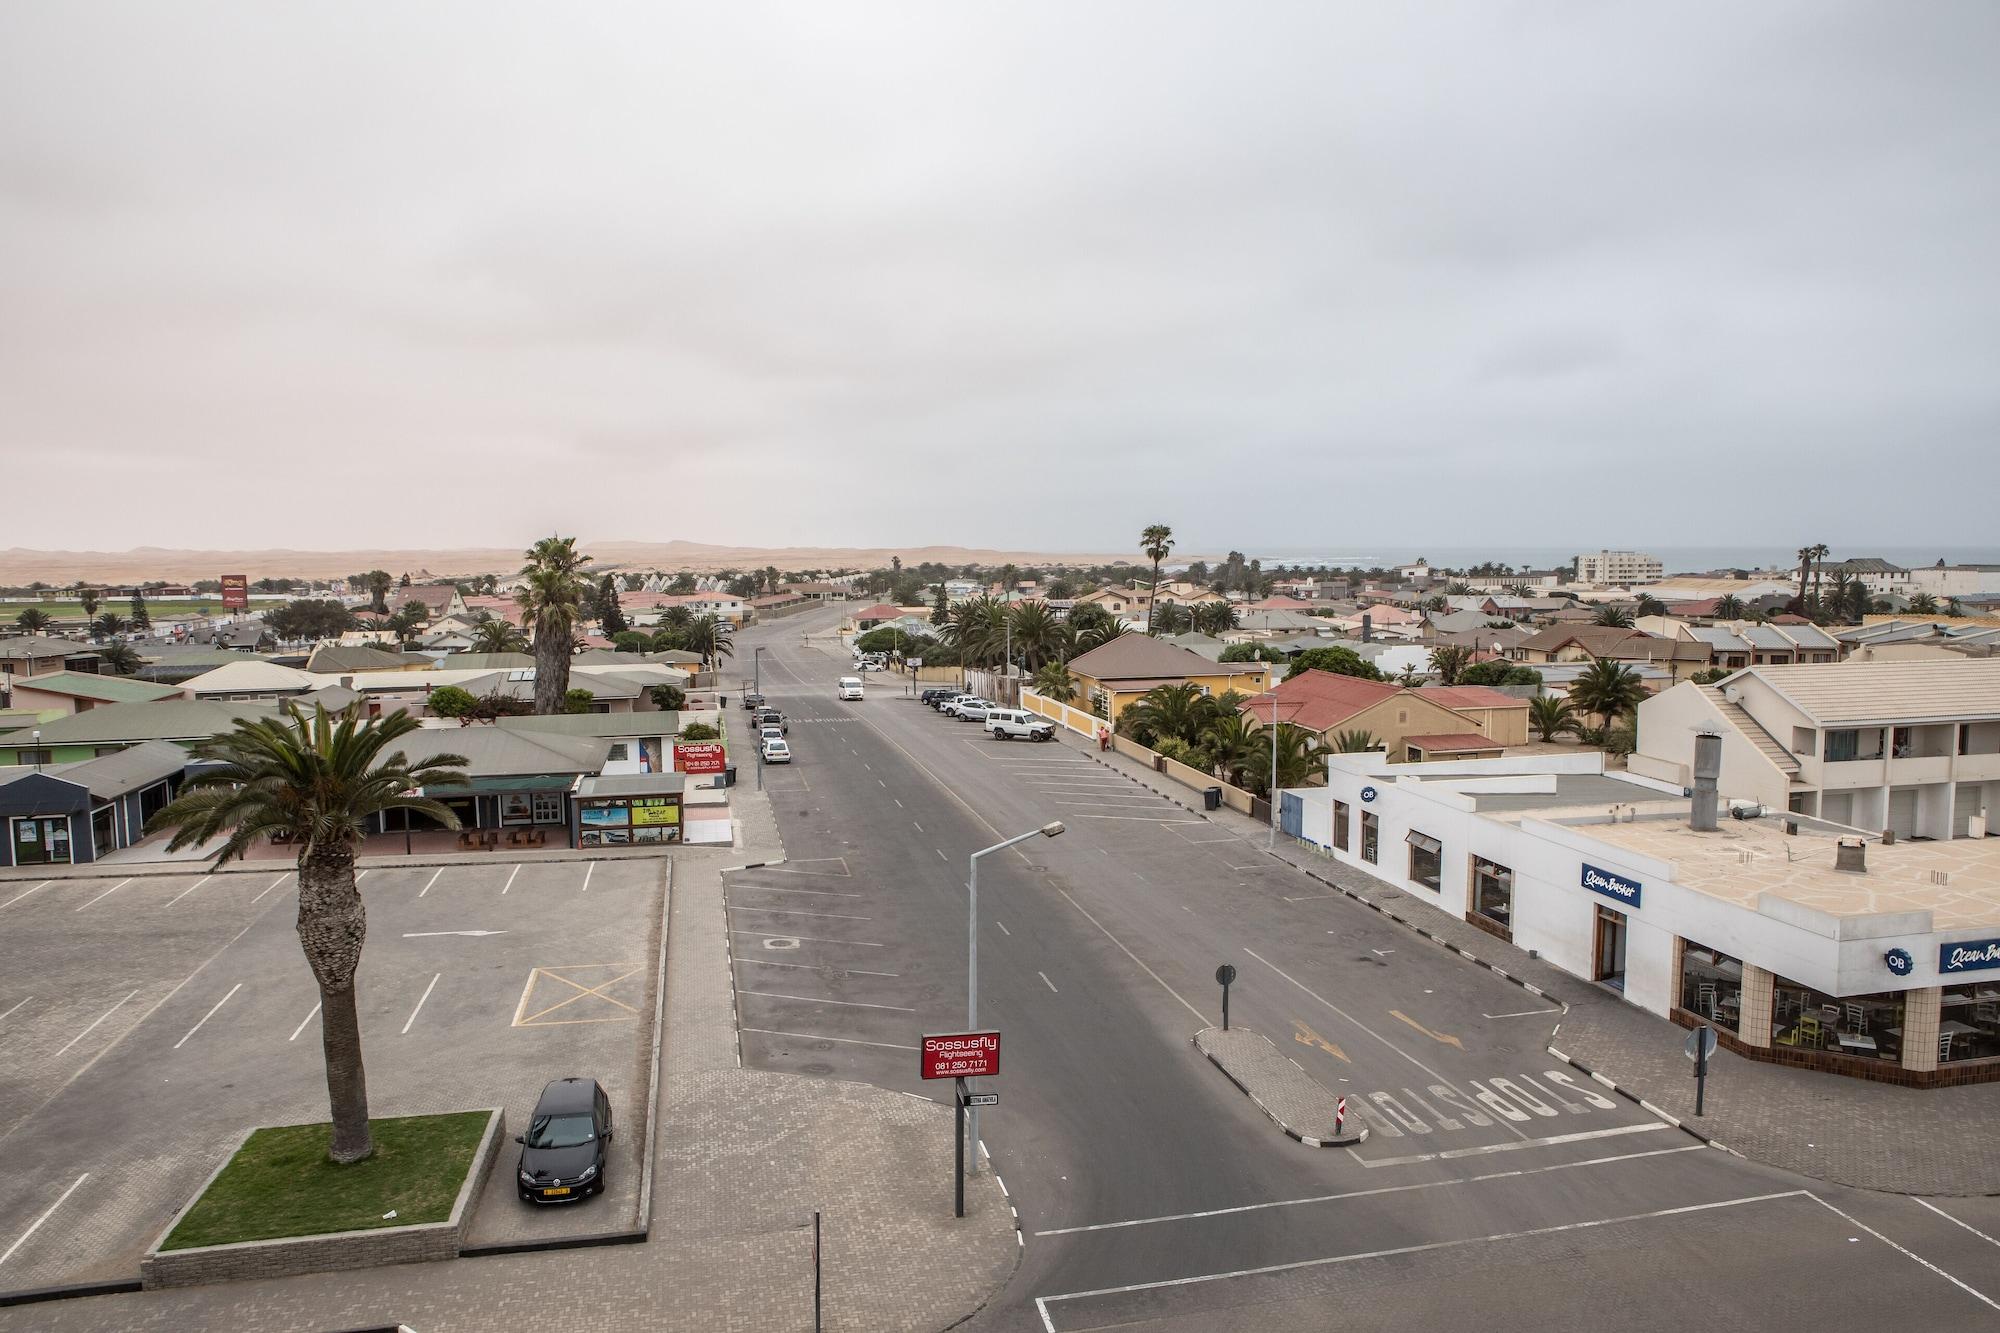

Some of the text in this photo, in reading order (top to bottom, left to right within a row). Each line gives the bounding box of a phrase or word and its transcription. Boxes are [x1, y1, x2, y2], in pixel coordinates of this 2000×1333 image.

[678, 745, 721, 753] Sossusfly
[1364, 791, 1374, 799] OB
[1584, 870, 1635, 898] Ocean Basket
[1889, 956, 1905, 969] OB
[1947, 947, 1985, 969] Ocean
[926, 1036, 997, 1052] Sossusfly
[939, 1050, 983, 1060] Flightseeing
[935, 1059, 987, 1070] 081 250 7171
[935, 1067, 987, 1075] www.sossusfly.com
[1469, 1070, 1617, 1122] STOP
[1349, 1084, 1494, 1137] STOP
